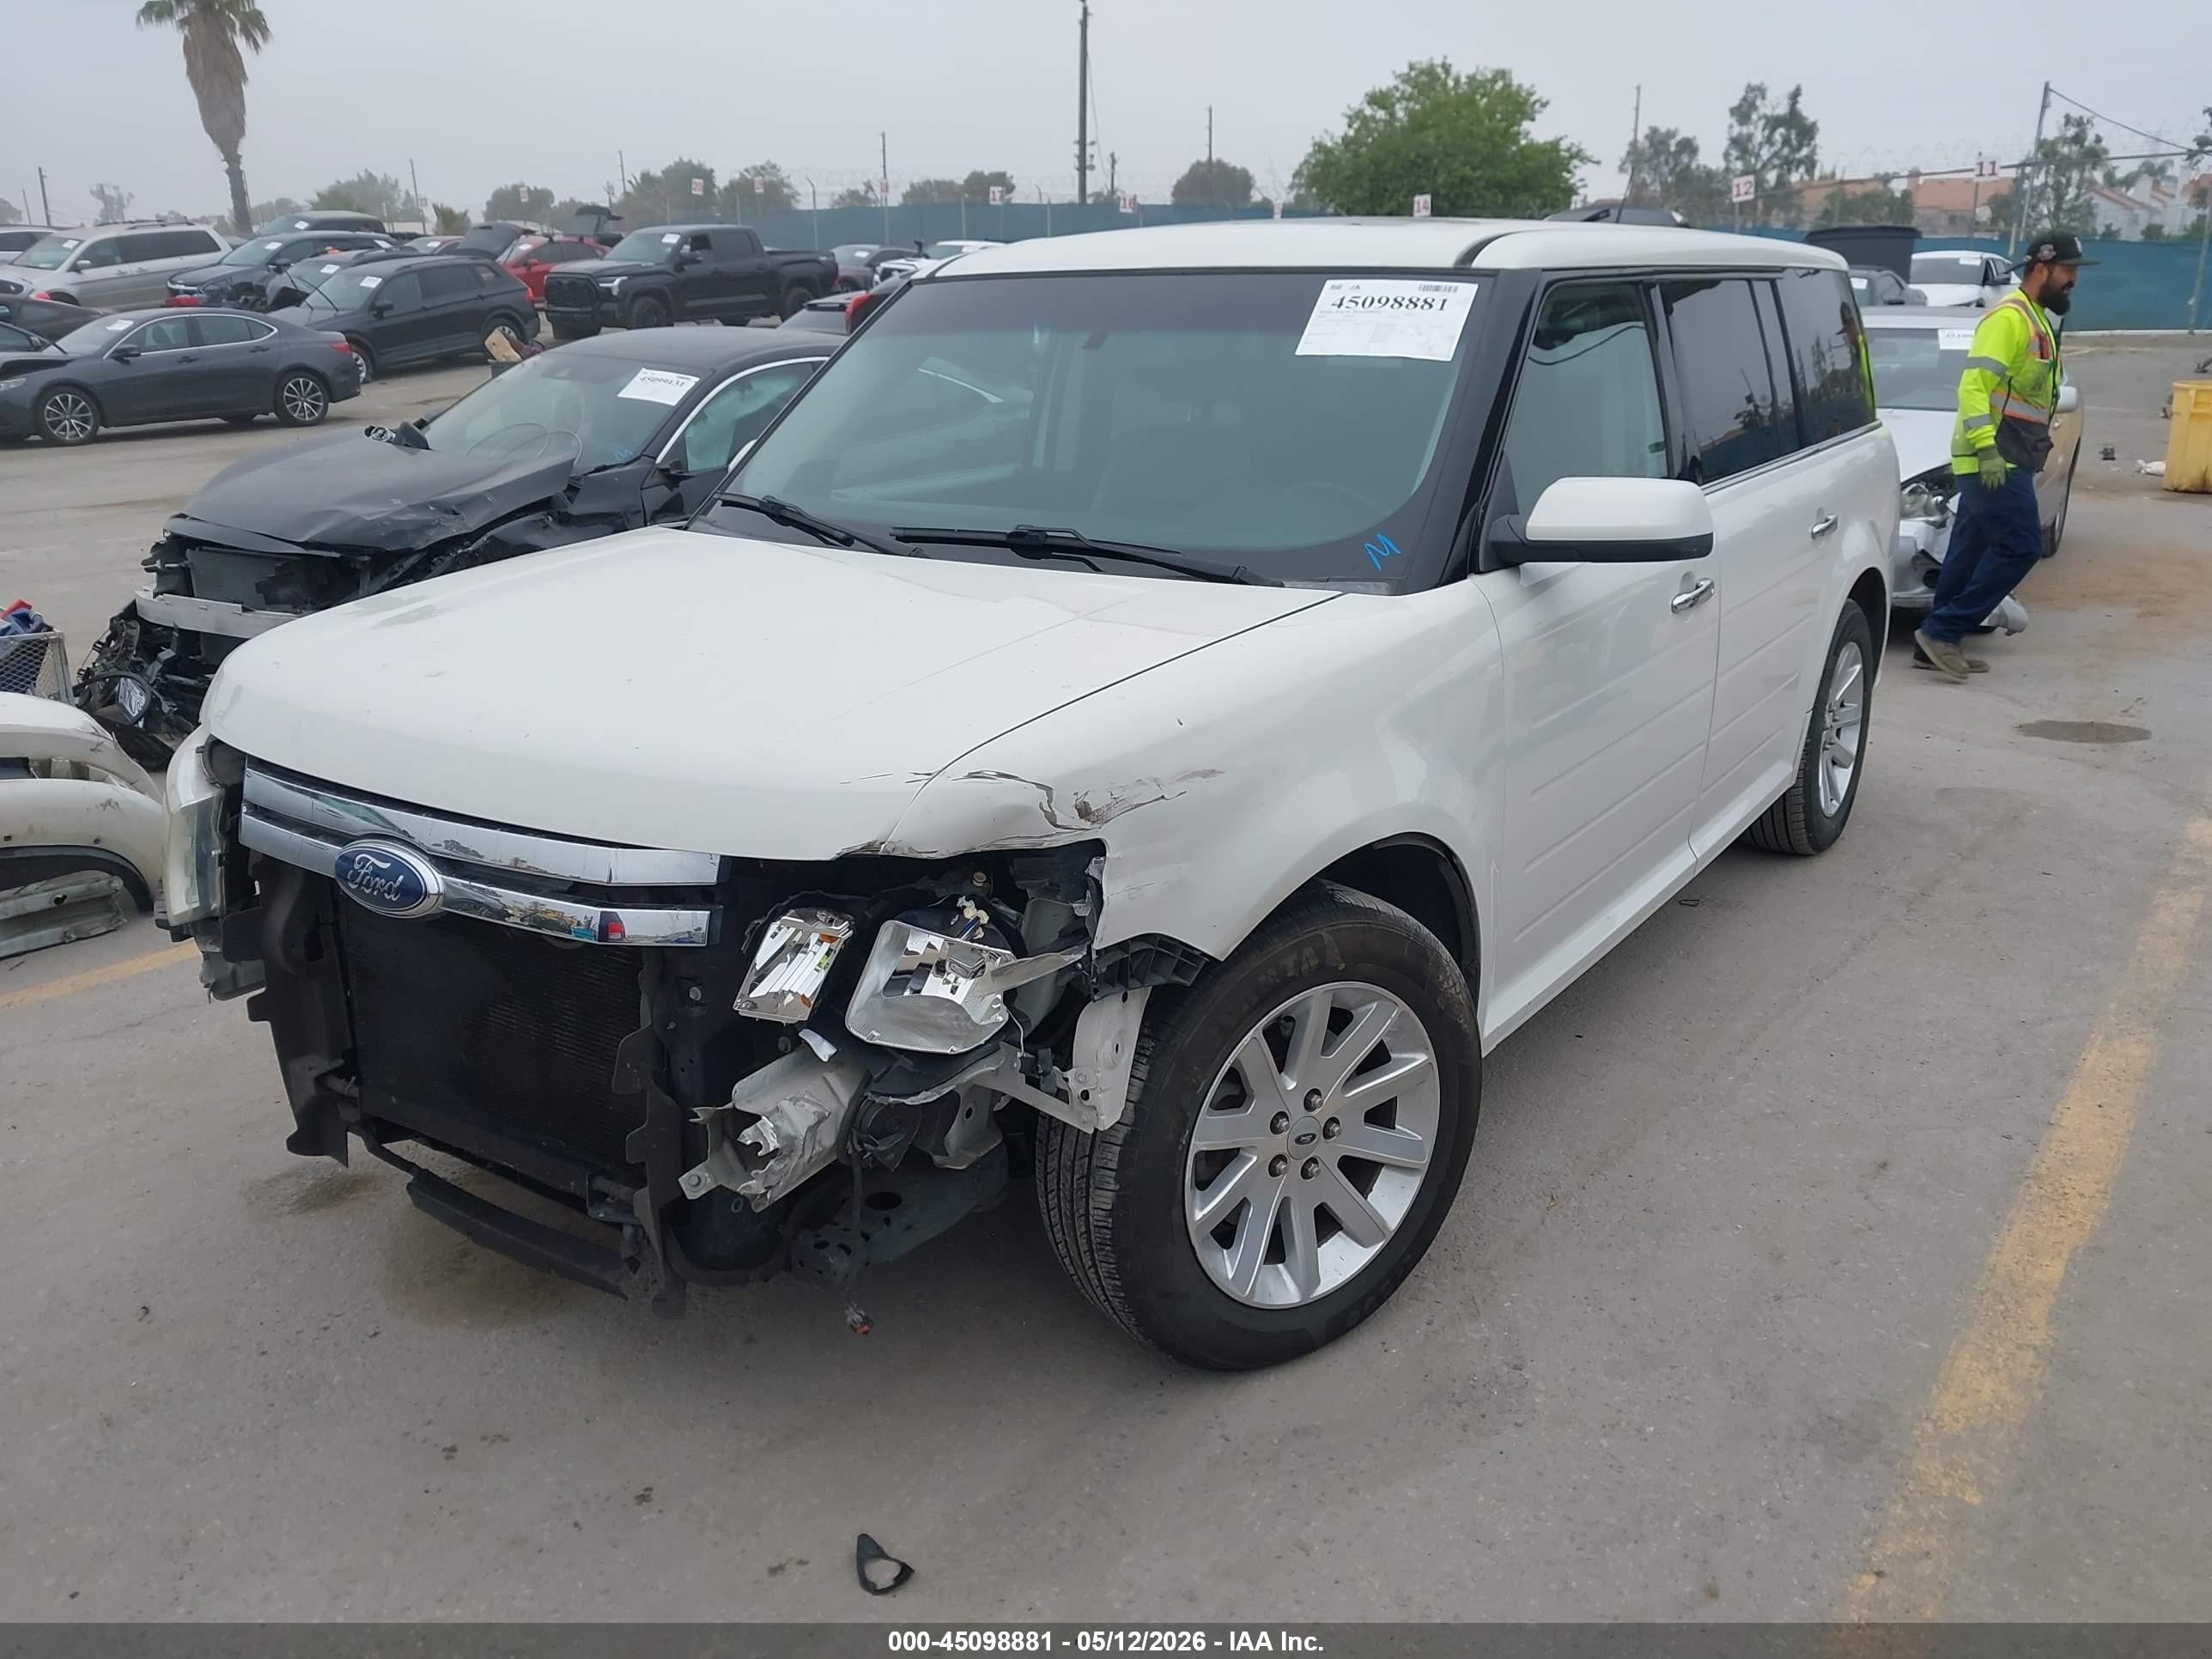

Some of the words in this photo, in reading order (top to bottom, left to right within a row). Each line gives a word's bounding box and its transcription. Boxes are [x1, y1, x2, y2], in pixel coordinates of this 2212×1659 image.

[1976, 161, 1997, 177] 11
[1735, 180, 1753, 197] 12
[1331, 295, 1449, 312] 45098881
[1364, 532, 1401, 571] M
[347, 854, 404, 902] Ford
